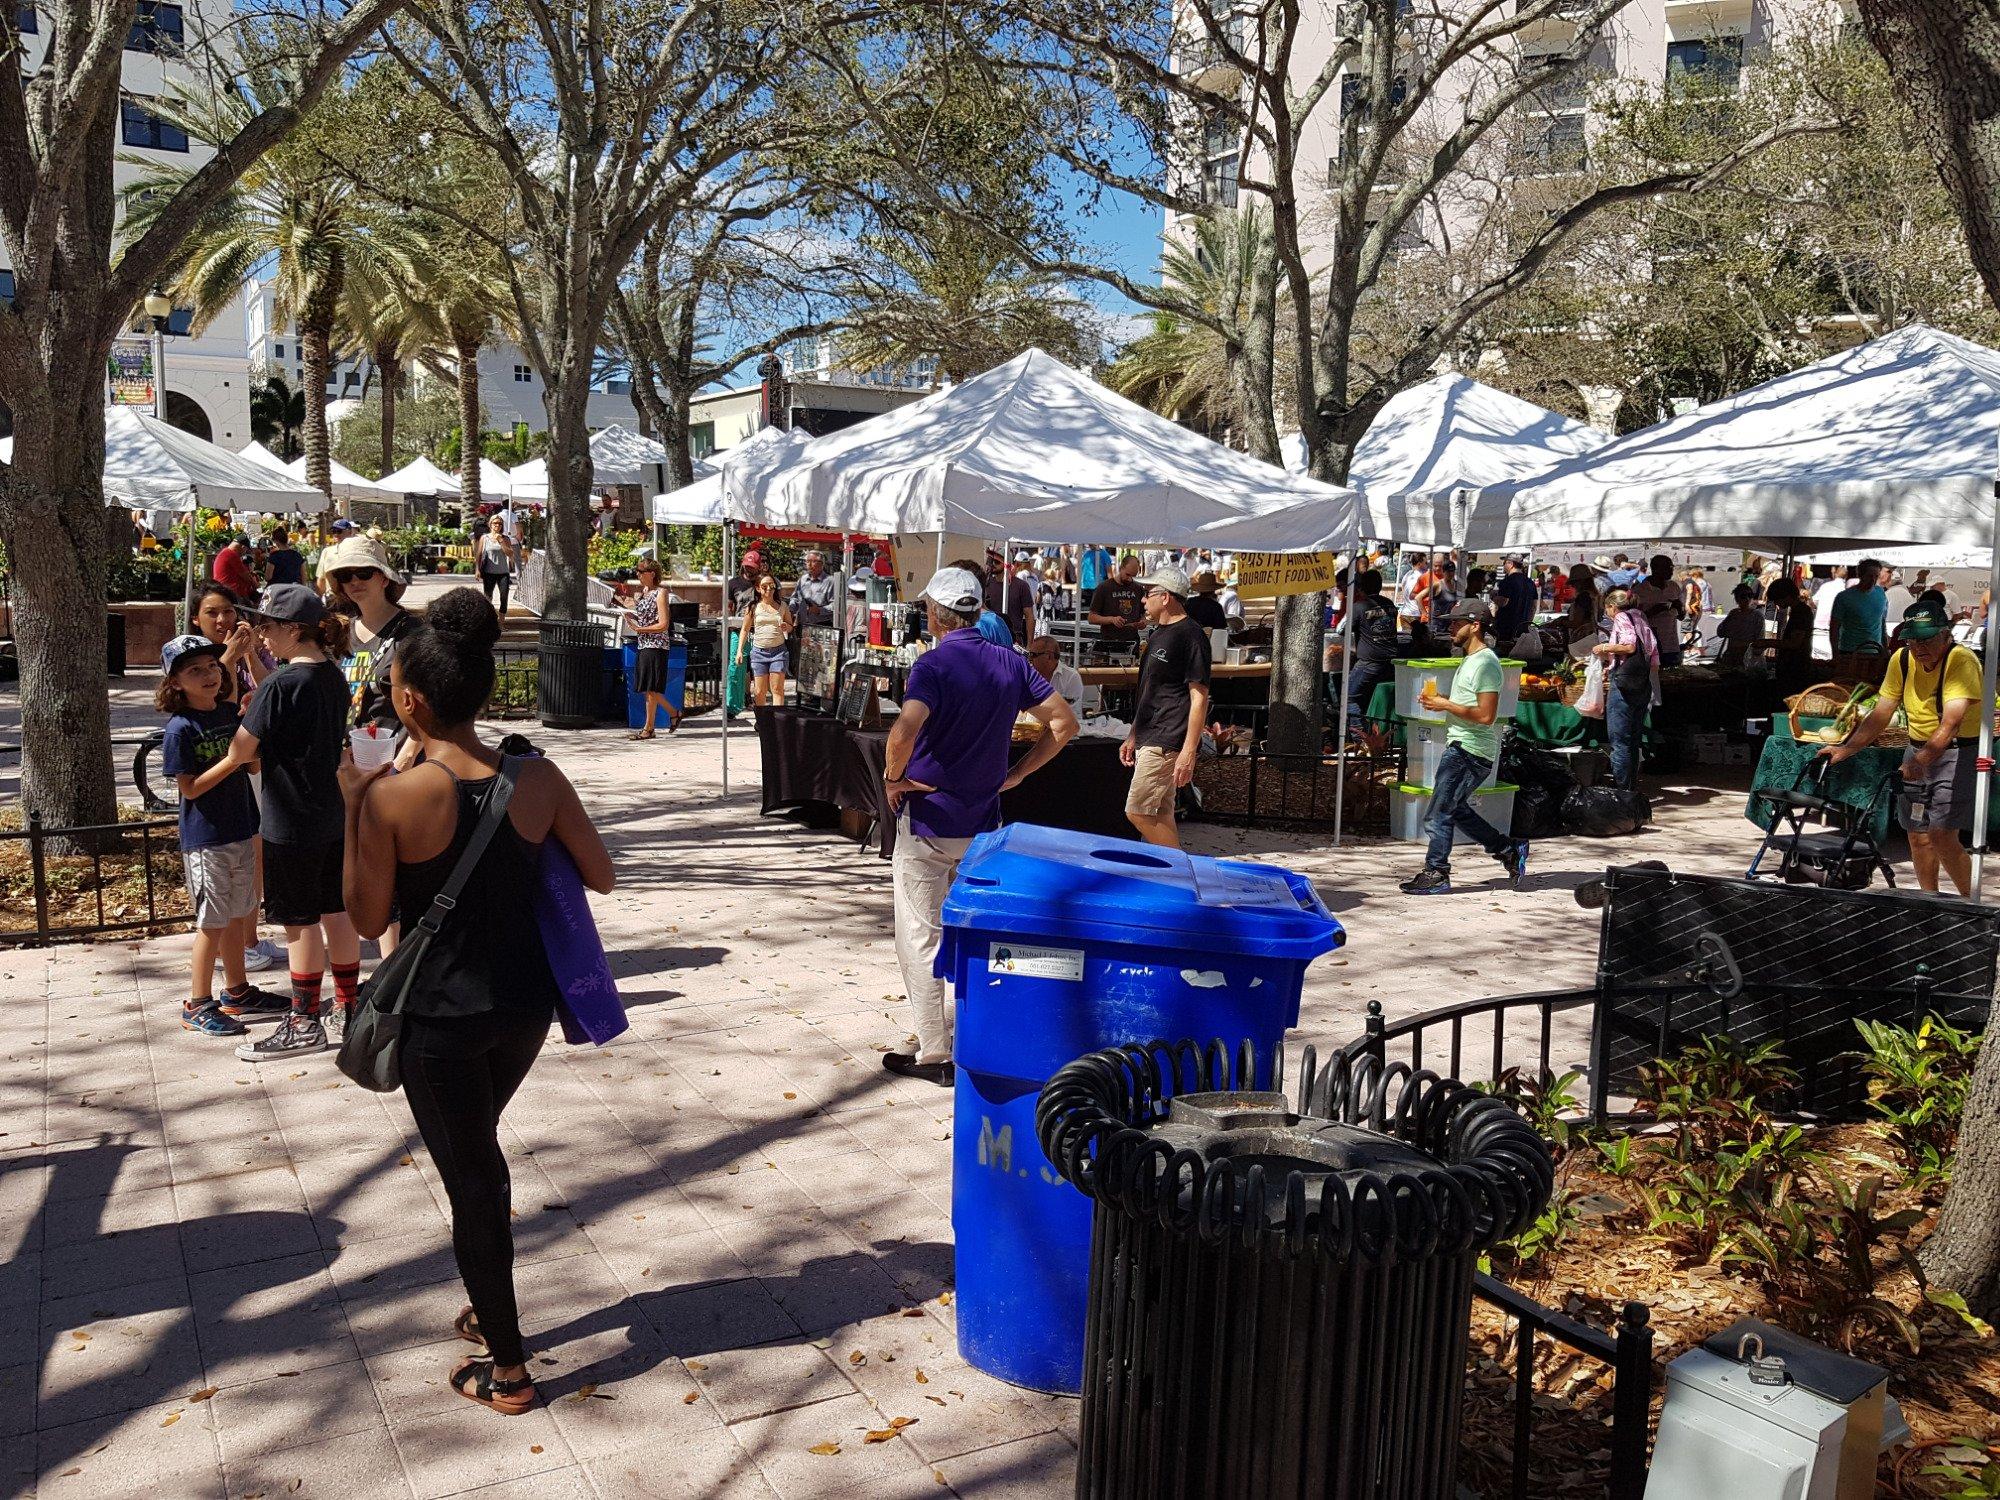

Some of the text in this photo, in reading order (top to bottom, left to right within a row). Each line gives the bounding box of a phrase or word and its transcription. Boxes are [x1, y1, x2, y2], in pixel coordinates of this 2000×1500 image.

[1238, 566, 1330, 587] GOURMET FOOD INC
